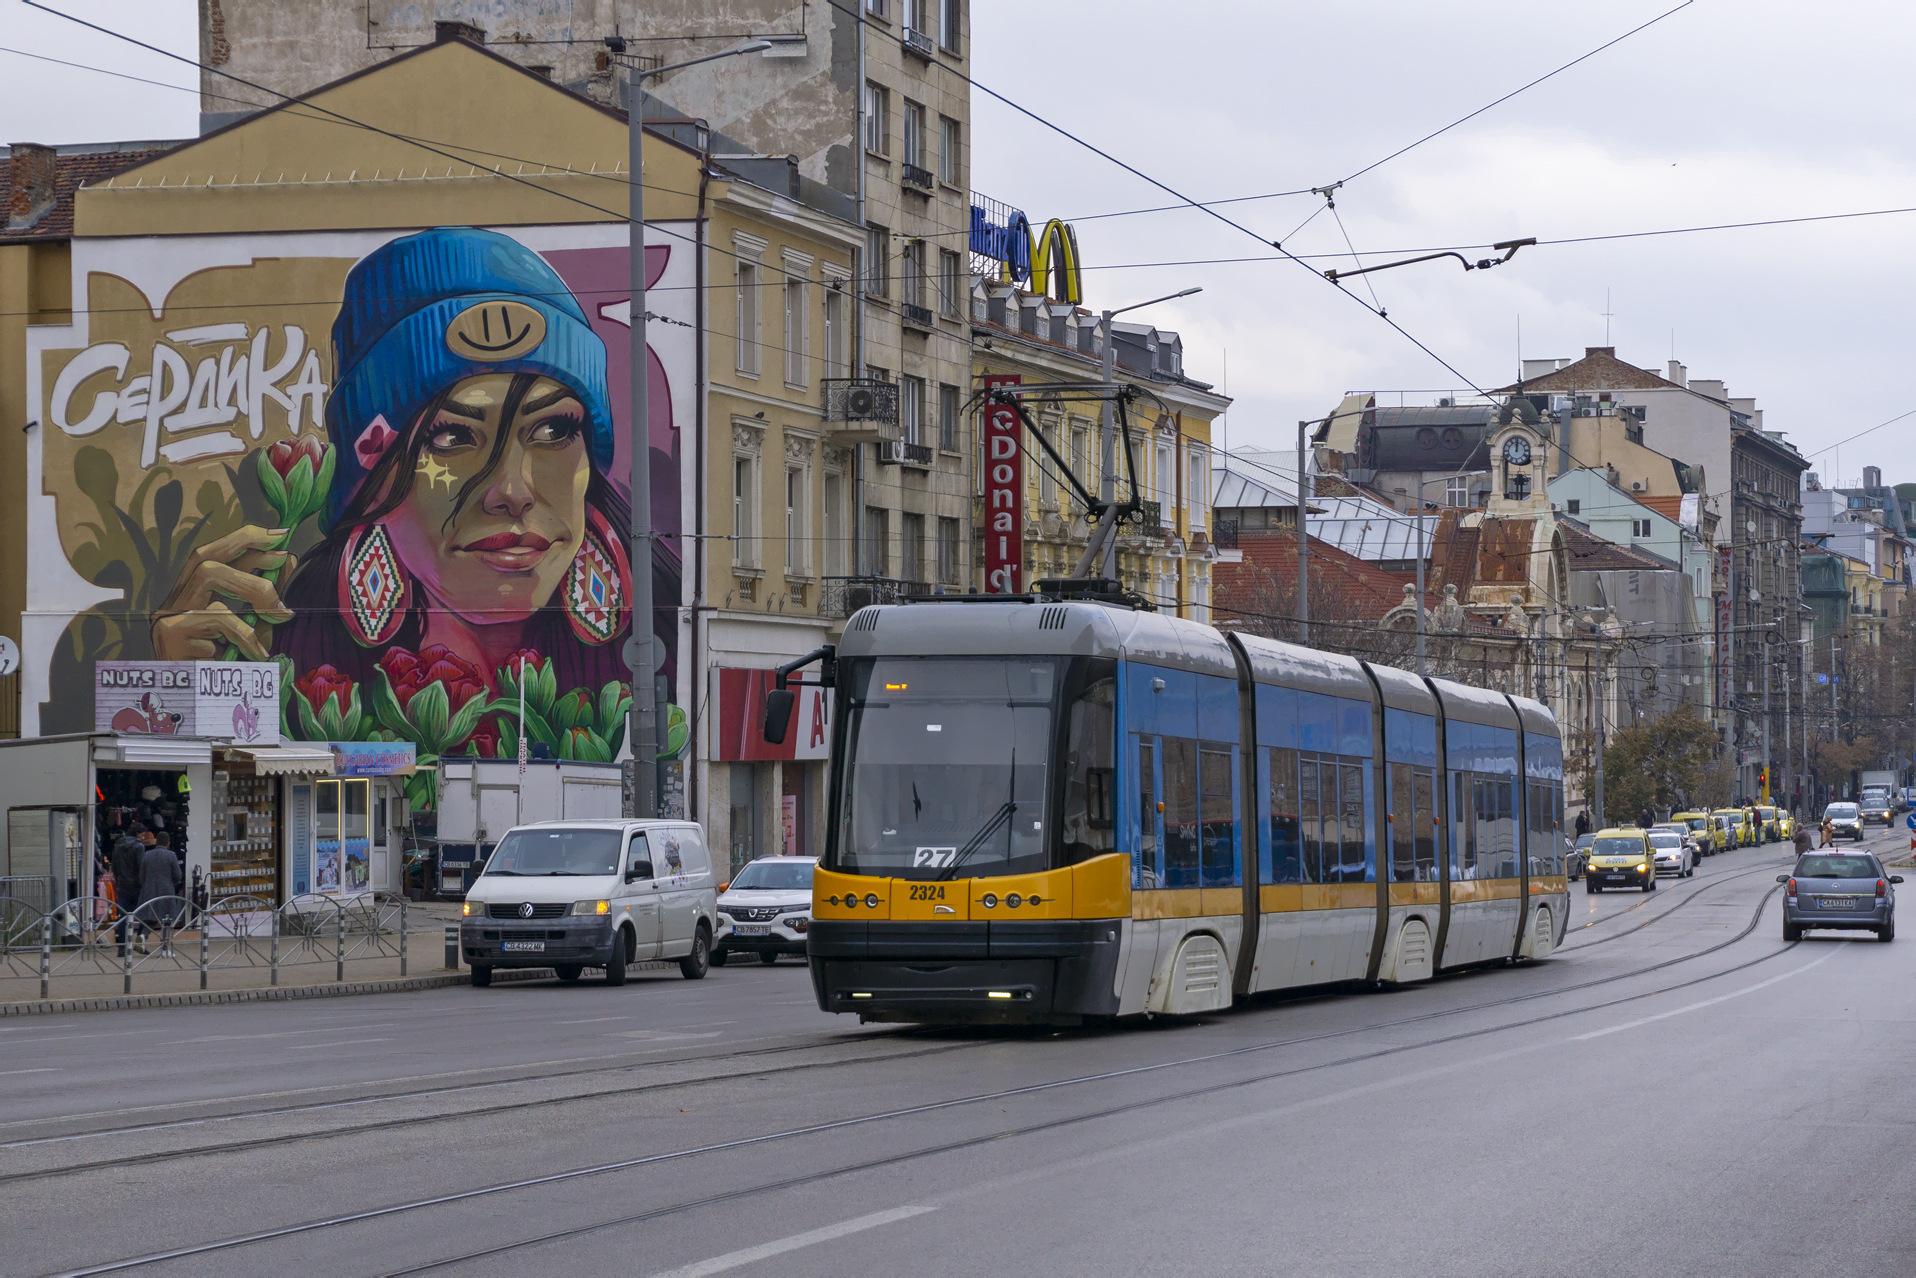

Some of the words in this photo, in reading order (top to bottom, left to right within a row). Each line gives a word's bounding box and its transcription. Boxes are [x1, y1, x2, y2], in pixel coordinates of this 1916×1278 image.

[101, 669, 155, 688] NUTS
[160, 669, 190, 688] BG
[200, 667, 243, 697] NUTS
[251, 669, 274, 698] BG
[336, 752, 375, 766] BULGARIAN
[375, 752, 411, 766] COSMETICS
[916, 849, 953, 867] 27
[909, 885, 945, 901] 2324
